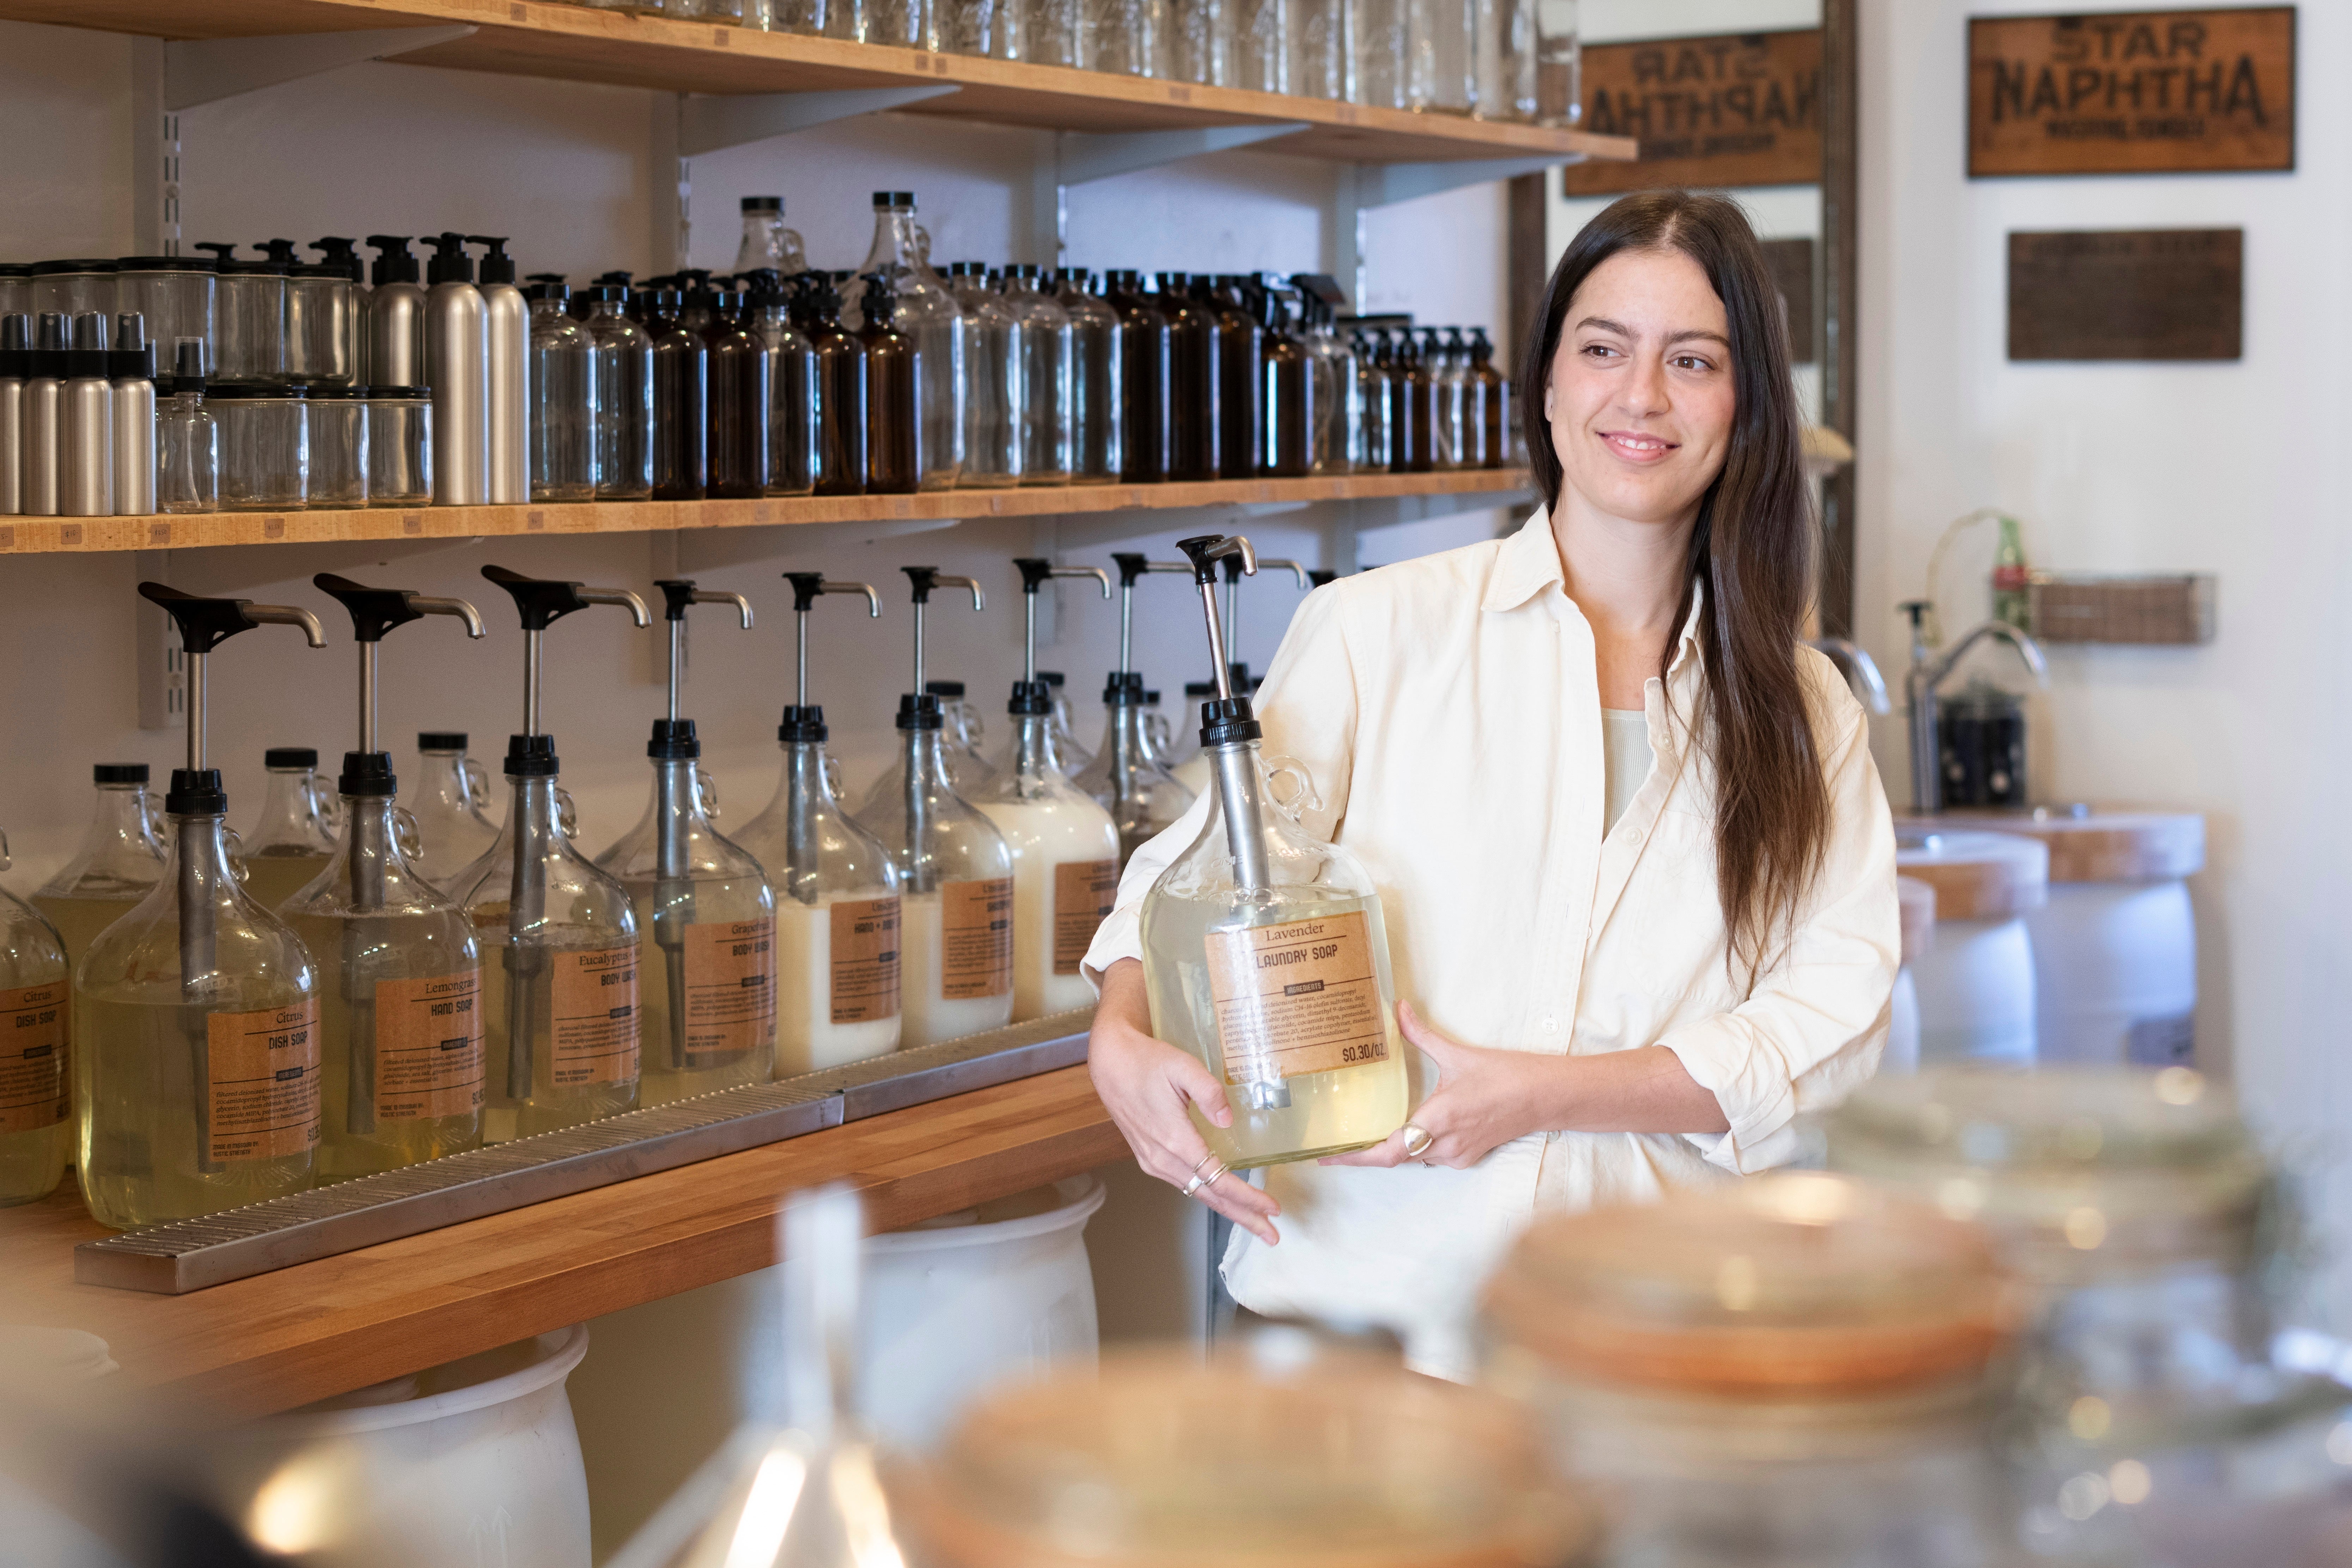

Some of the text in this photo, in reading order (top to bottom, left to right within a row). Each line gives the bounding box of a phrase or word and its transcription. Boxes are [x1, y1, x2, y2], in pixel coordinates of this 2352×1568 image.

[2051, 18, 2208, 63] STAR
[1992, 52, 2268, 128] NAPHTHA
[1266, 923, 1324, 941] Lavender
[579, 952, 628, 965] Eucalyptus
[1256, 944, 1338, 969] LAUNDRY SOAP
[426, 978, 476, 994] Lemongrass
[601, 972, 620, 986] BODY
[1287, 981, 1322, 994] INGREDIENTS
[1317, 989, 1357, 1000] cocamidopropyl
[24, 991, 51, 1002] Citrus
[431, 998, 473, 1017] HAND SOAP
[1271, 1007, 1293, 1015] sodium
[1281, 1013, 1306, 1022] glycerin,
[1308, 1007, 1332, 1017] dimethyl
[16, 1009, 56, 1028] DISH SOAP
[276, 1011, 303, 1024] Citrus
[1267, 1022, 1297, 1031] glucoside,
[1298, 1017, 1324, 1025] cocamide
[1300, 1025, 1323, 1033] acrylate
[269, 1030, 308, 1050] DISH SOAP
